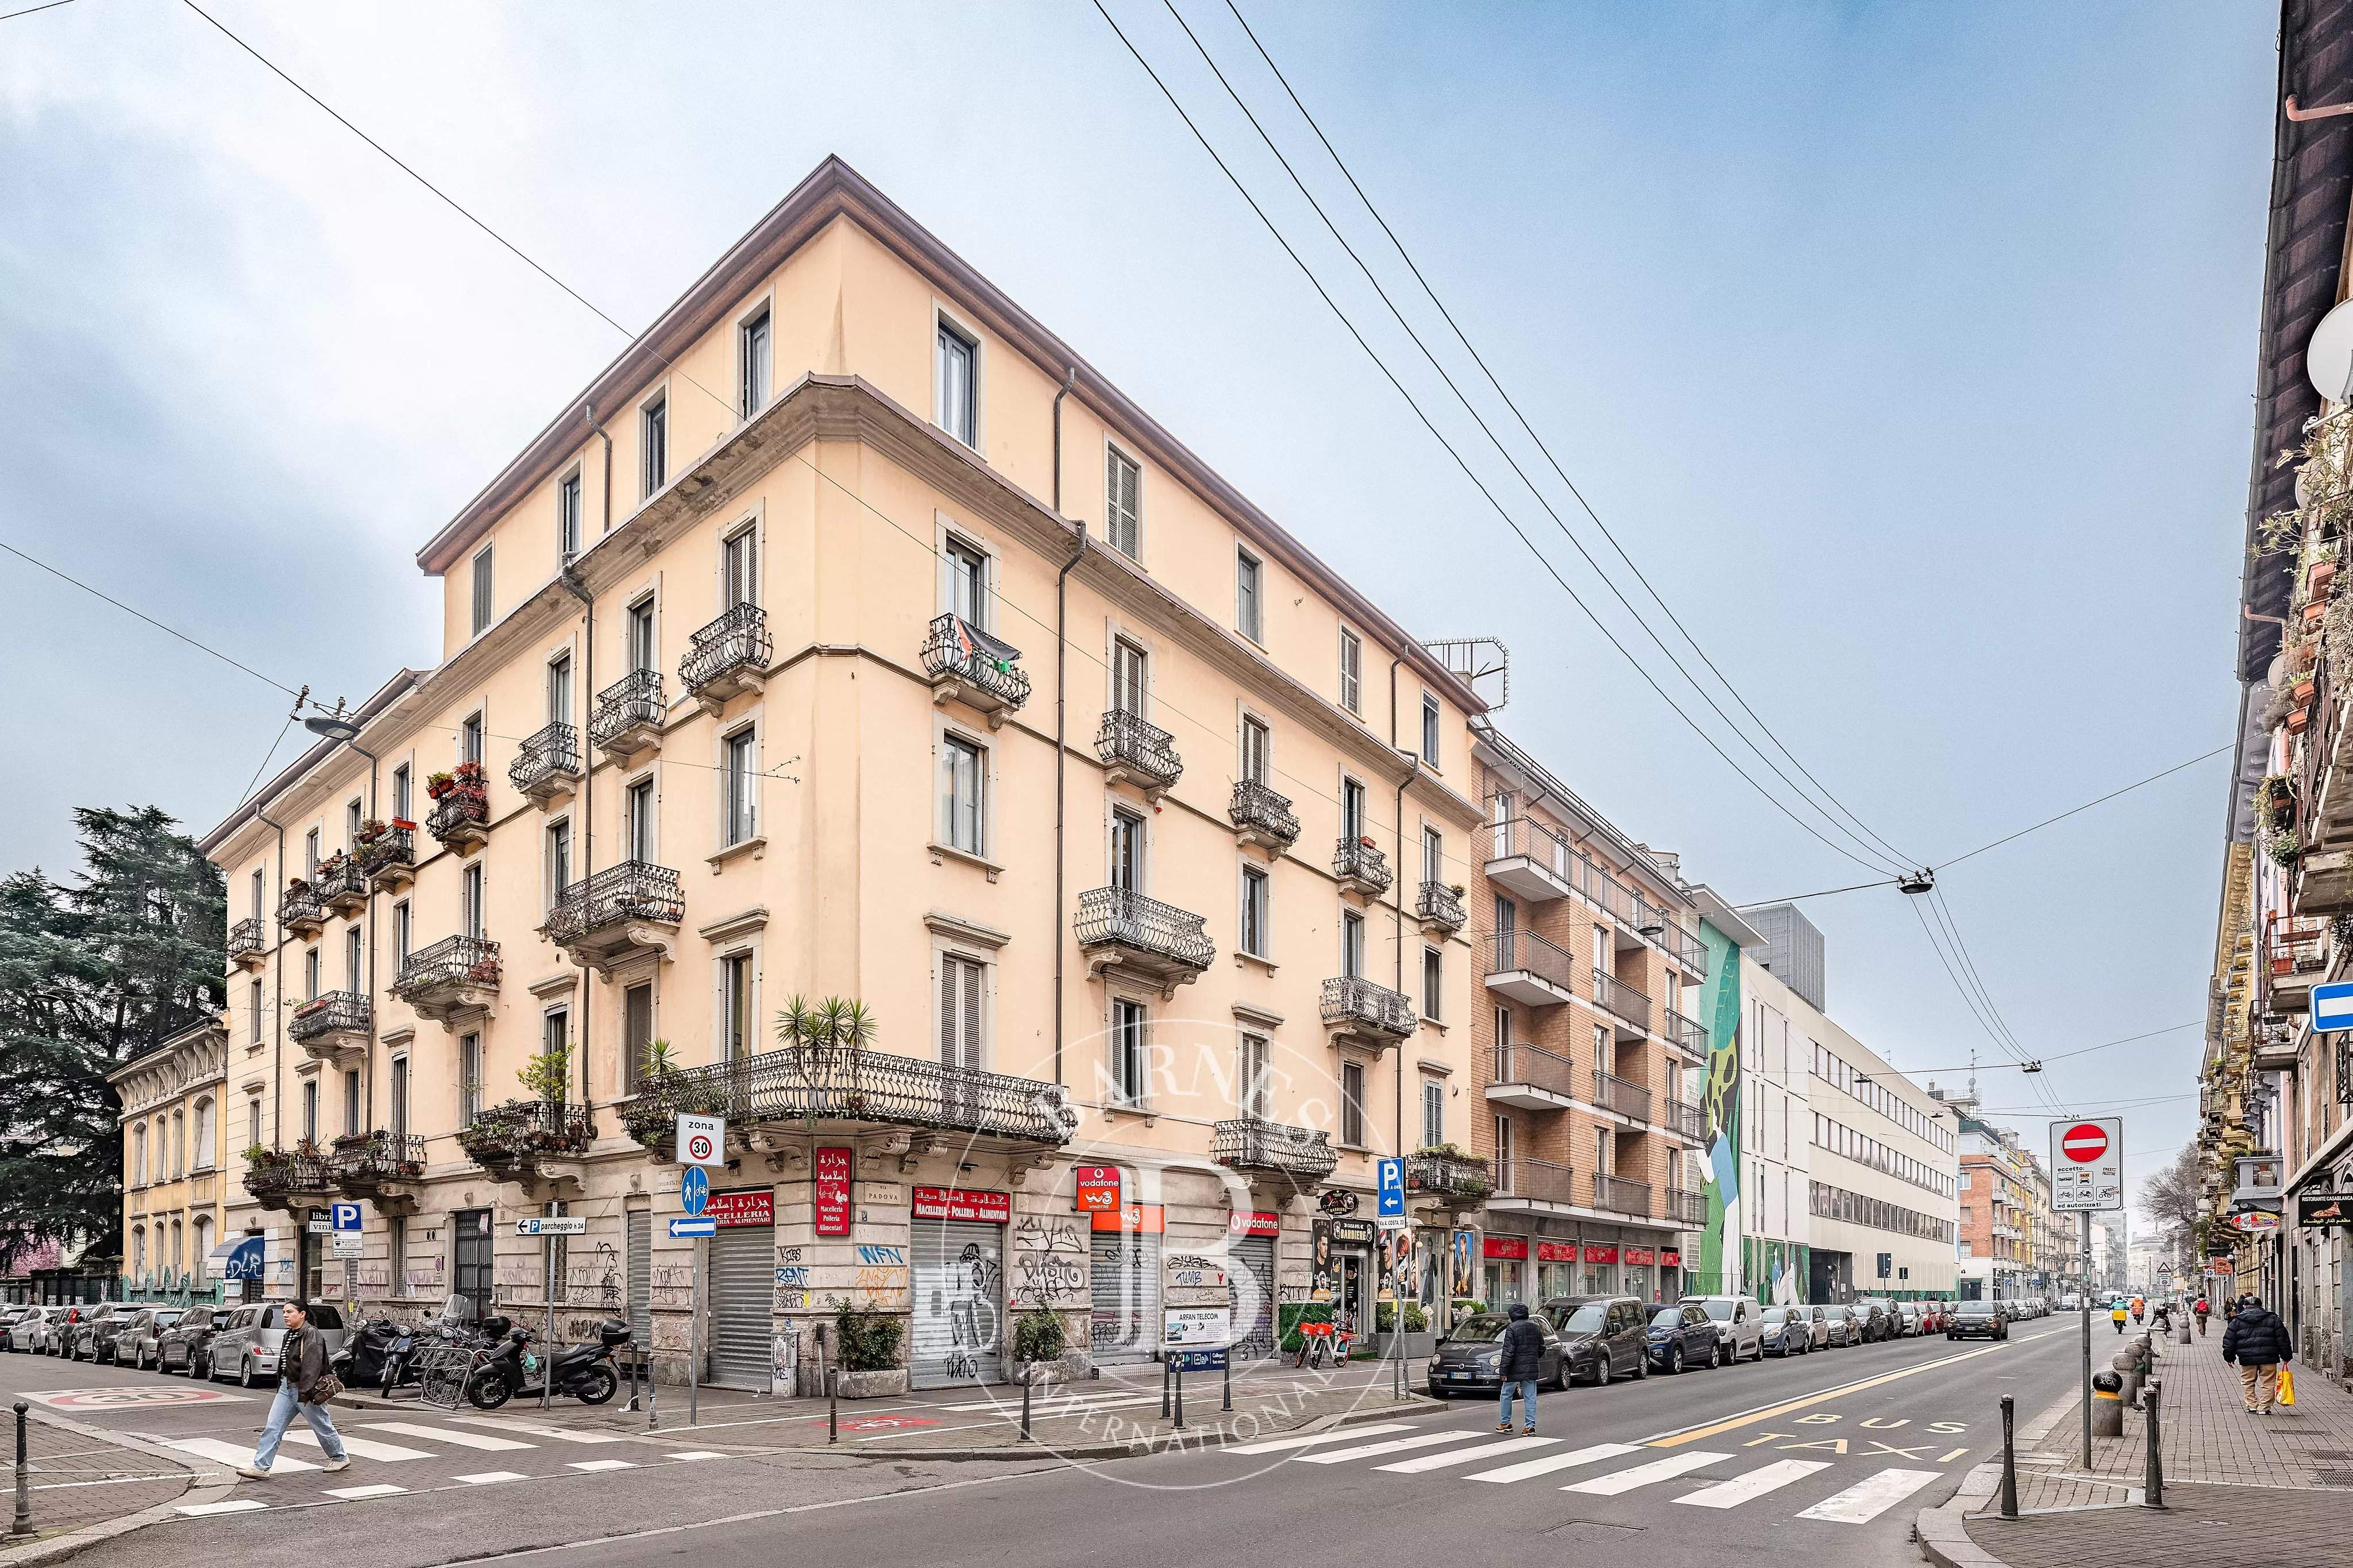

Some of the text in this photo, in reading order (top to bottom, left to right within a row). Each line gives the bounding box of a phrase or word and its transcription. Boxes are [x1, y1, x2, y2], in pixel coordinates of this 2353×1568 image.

[688, 1121, 714, 1131] zona
[693, 1141, 708, 1154] 30
[1384, 1163, 1398, 1191] P
[312, 1212, 331, 1220] libri
[338, 1206, 357, 1228] P
[916, 1203, 1007, 1220] MACELLERIA POLLERIA ALIMENTARI
[531, 1221, 538, 1231] P
[541, 1221, 573, 1231] parcheggio
[1241, 1216, 1278, 1229] vodafone
[1340, 1229, 1367, 1241] BARBIERE
[91, 1393, 185, 1403] 30
[1792, 1413, 1971, 1434] BUS
[1741, 1432, 1971, 1463] TAXI
